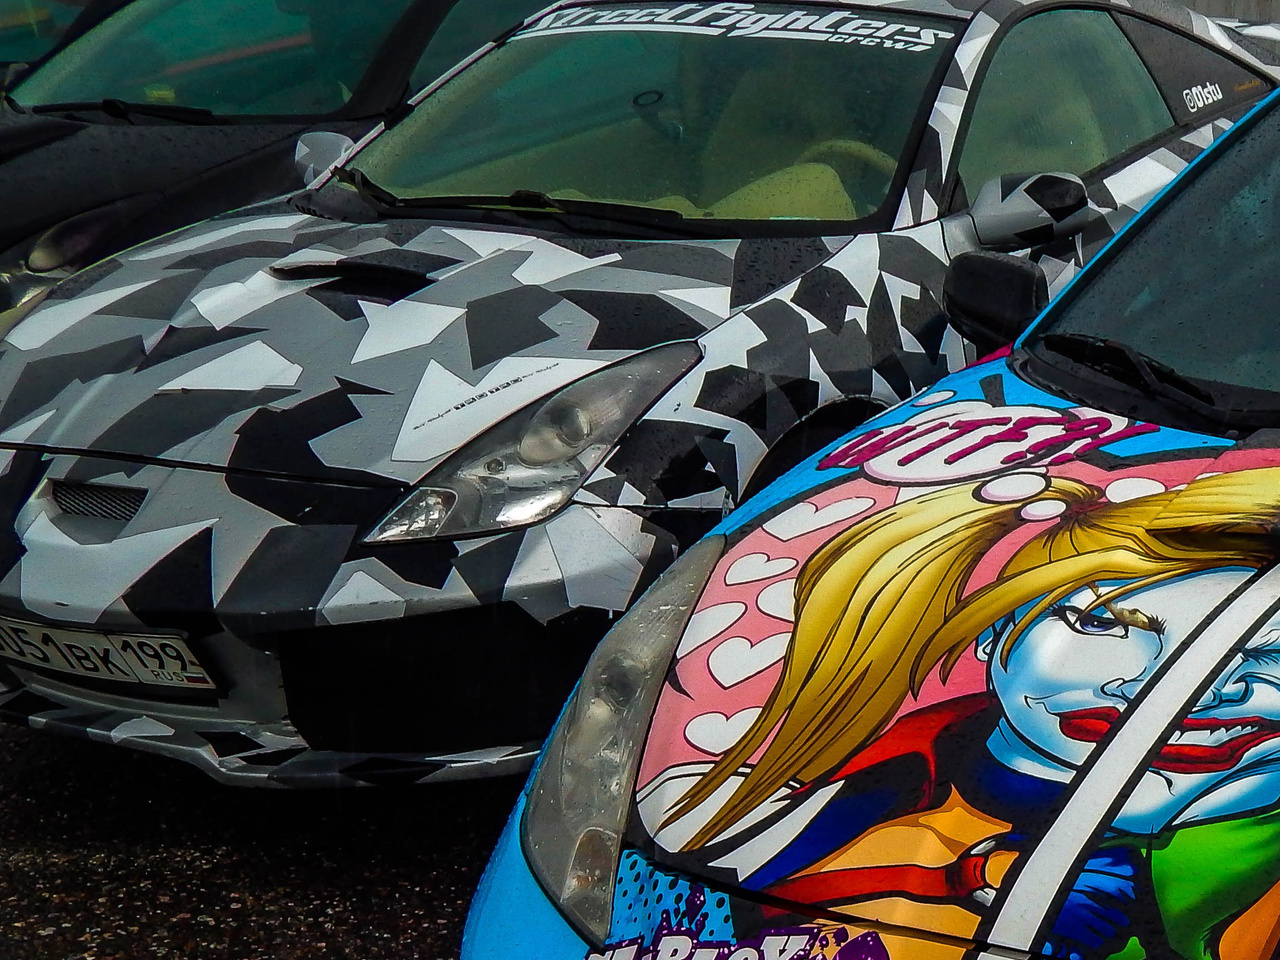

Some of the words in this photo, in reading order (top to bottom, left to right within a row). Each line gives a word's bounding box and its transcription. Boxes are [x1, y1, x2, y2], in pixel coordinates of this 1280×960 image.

[0, 625, 130, 677] 051BK
[120, 639, 188, 671] 199
[152, 668, 185, 682] RUS
